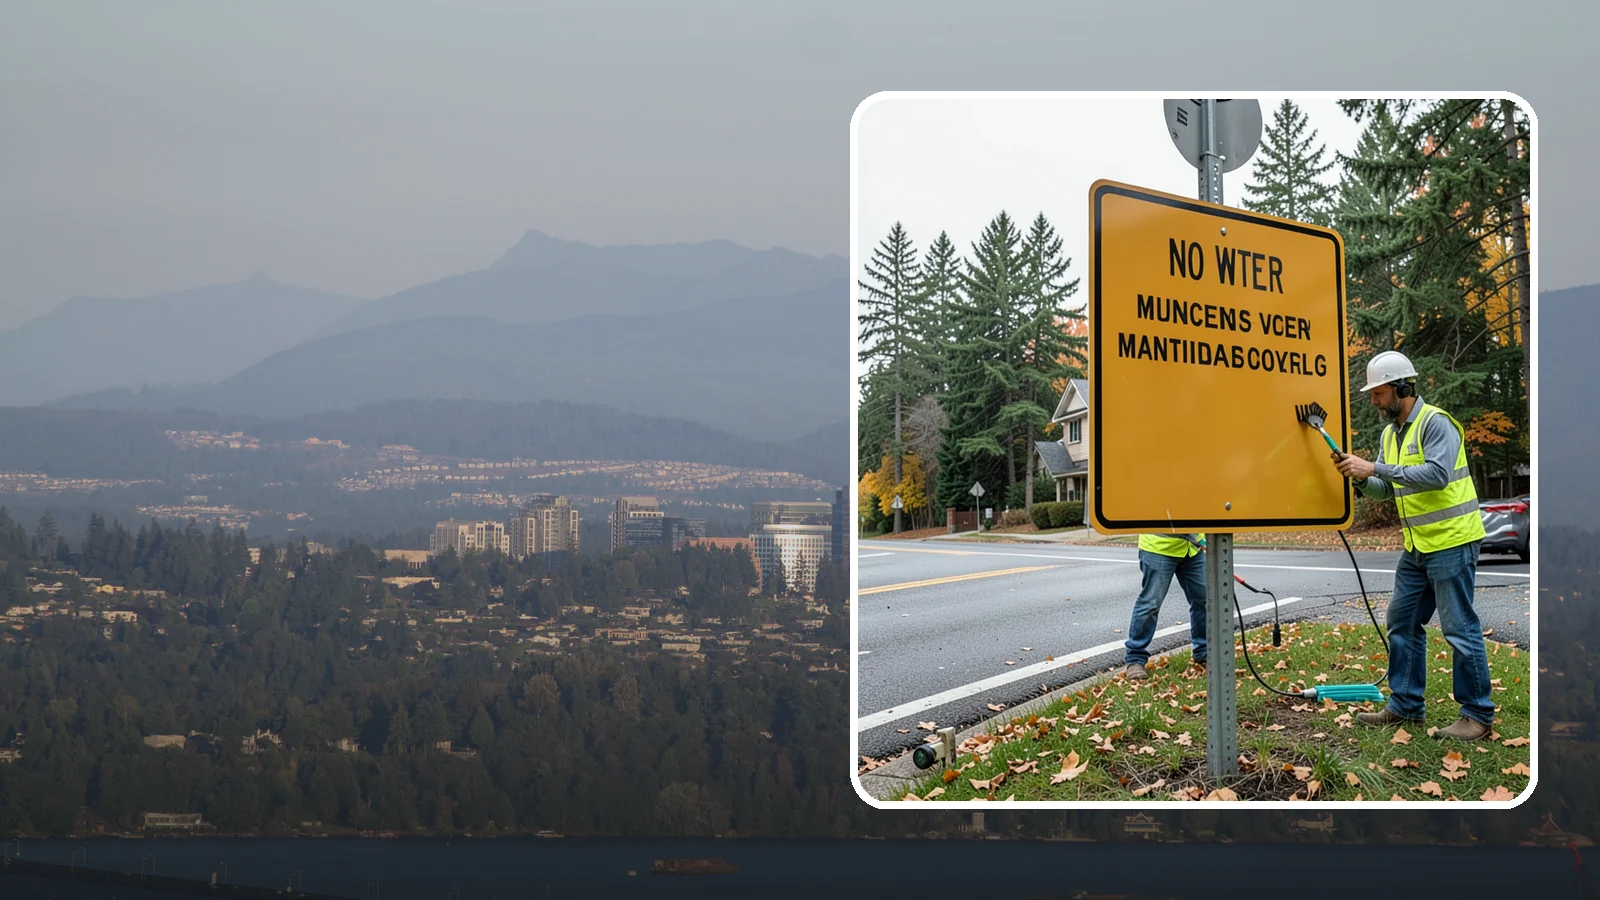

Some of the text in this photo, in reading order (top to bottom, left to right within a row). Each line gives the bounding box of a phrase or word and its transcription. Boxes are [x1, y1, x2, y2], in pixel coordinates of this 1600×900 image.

[1169, 237, 1284, 294] NO WTER
[1137, 293, 1252, 333] MUNCENS
